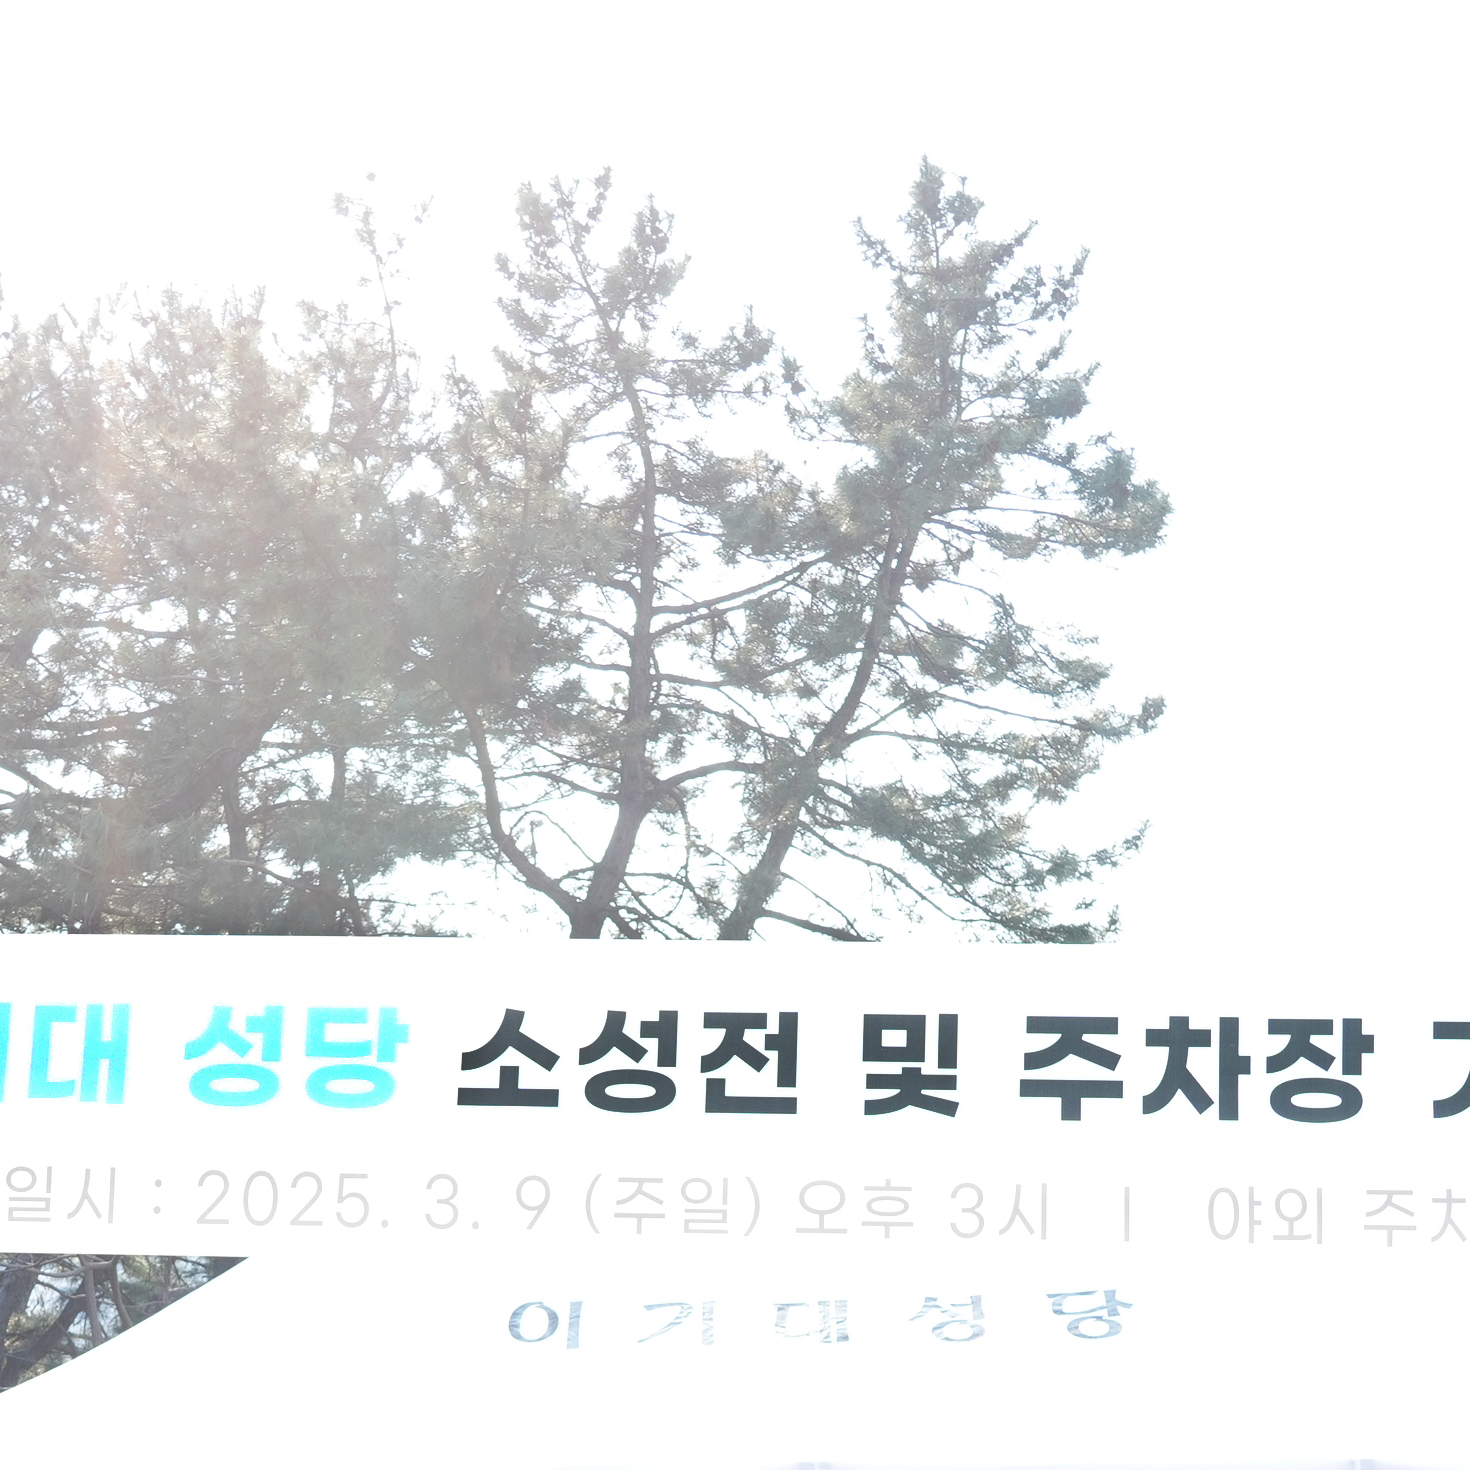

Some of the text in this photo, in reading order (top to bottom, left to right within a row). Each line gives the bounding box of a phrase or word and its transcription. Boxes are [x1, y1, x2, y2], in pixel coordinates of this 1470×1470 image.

[183, 1002, 411, 1110] 성당
[457, 1008, 799, 1116] 소성전
[862, 1013, 960, 1118] 및
[1019, 1016, 1375, 1124] 주차장
[5, 1165, 116, 1224] 일시
[197, 1169, 390, 1229] 2025.
[424, 1173, 481, 1230] 3.
[515, 1174, 551, 1230] 9
[585, 1173, 761, 1237] (주일)
[795, 1178, 914, 1239] 오후
[949, 1182, 1048, 1241] 3시
[1207, 1186, 1323, 1246] 야외
